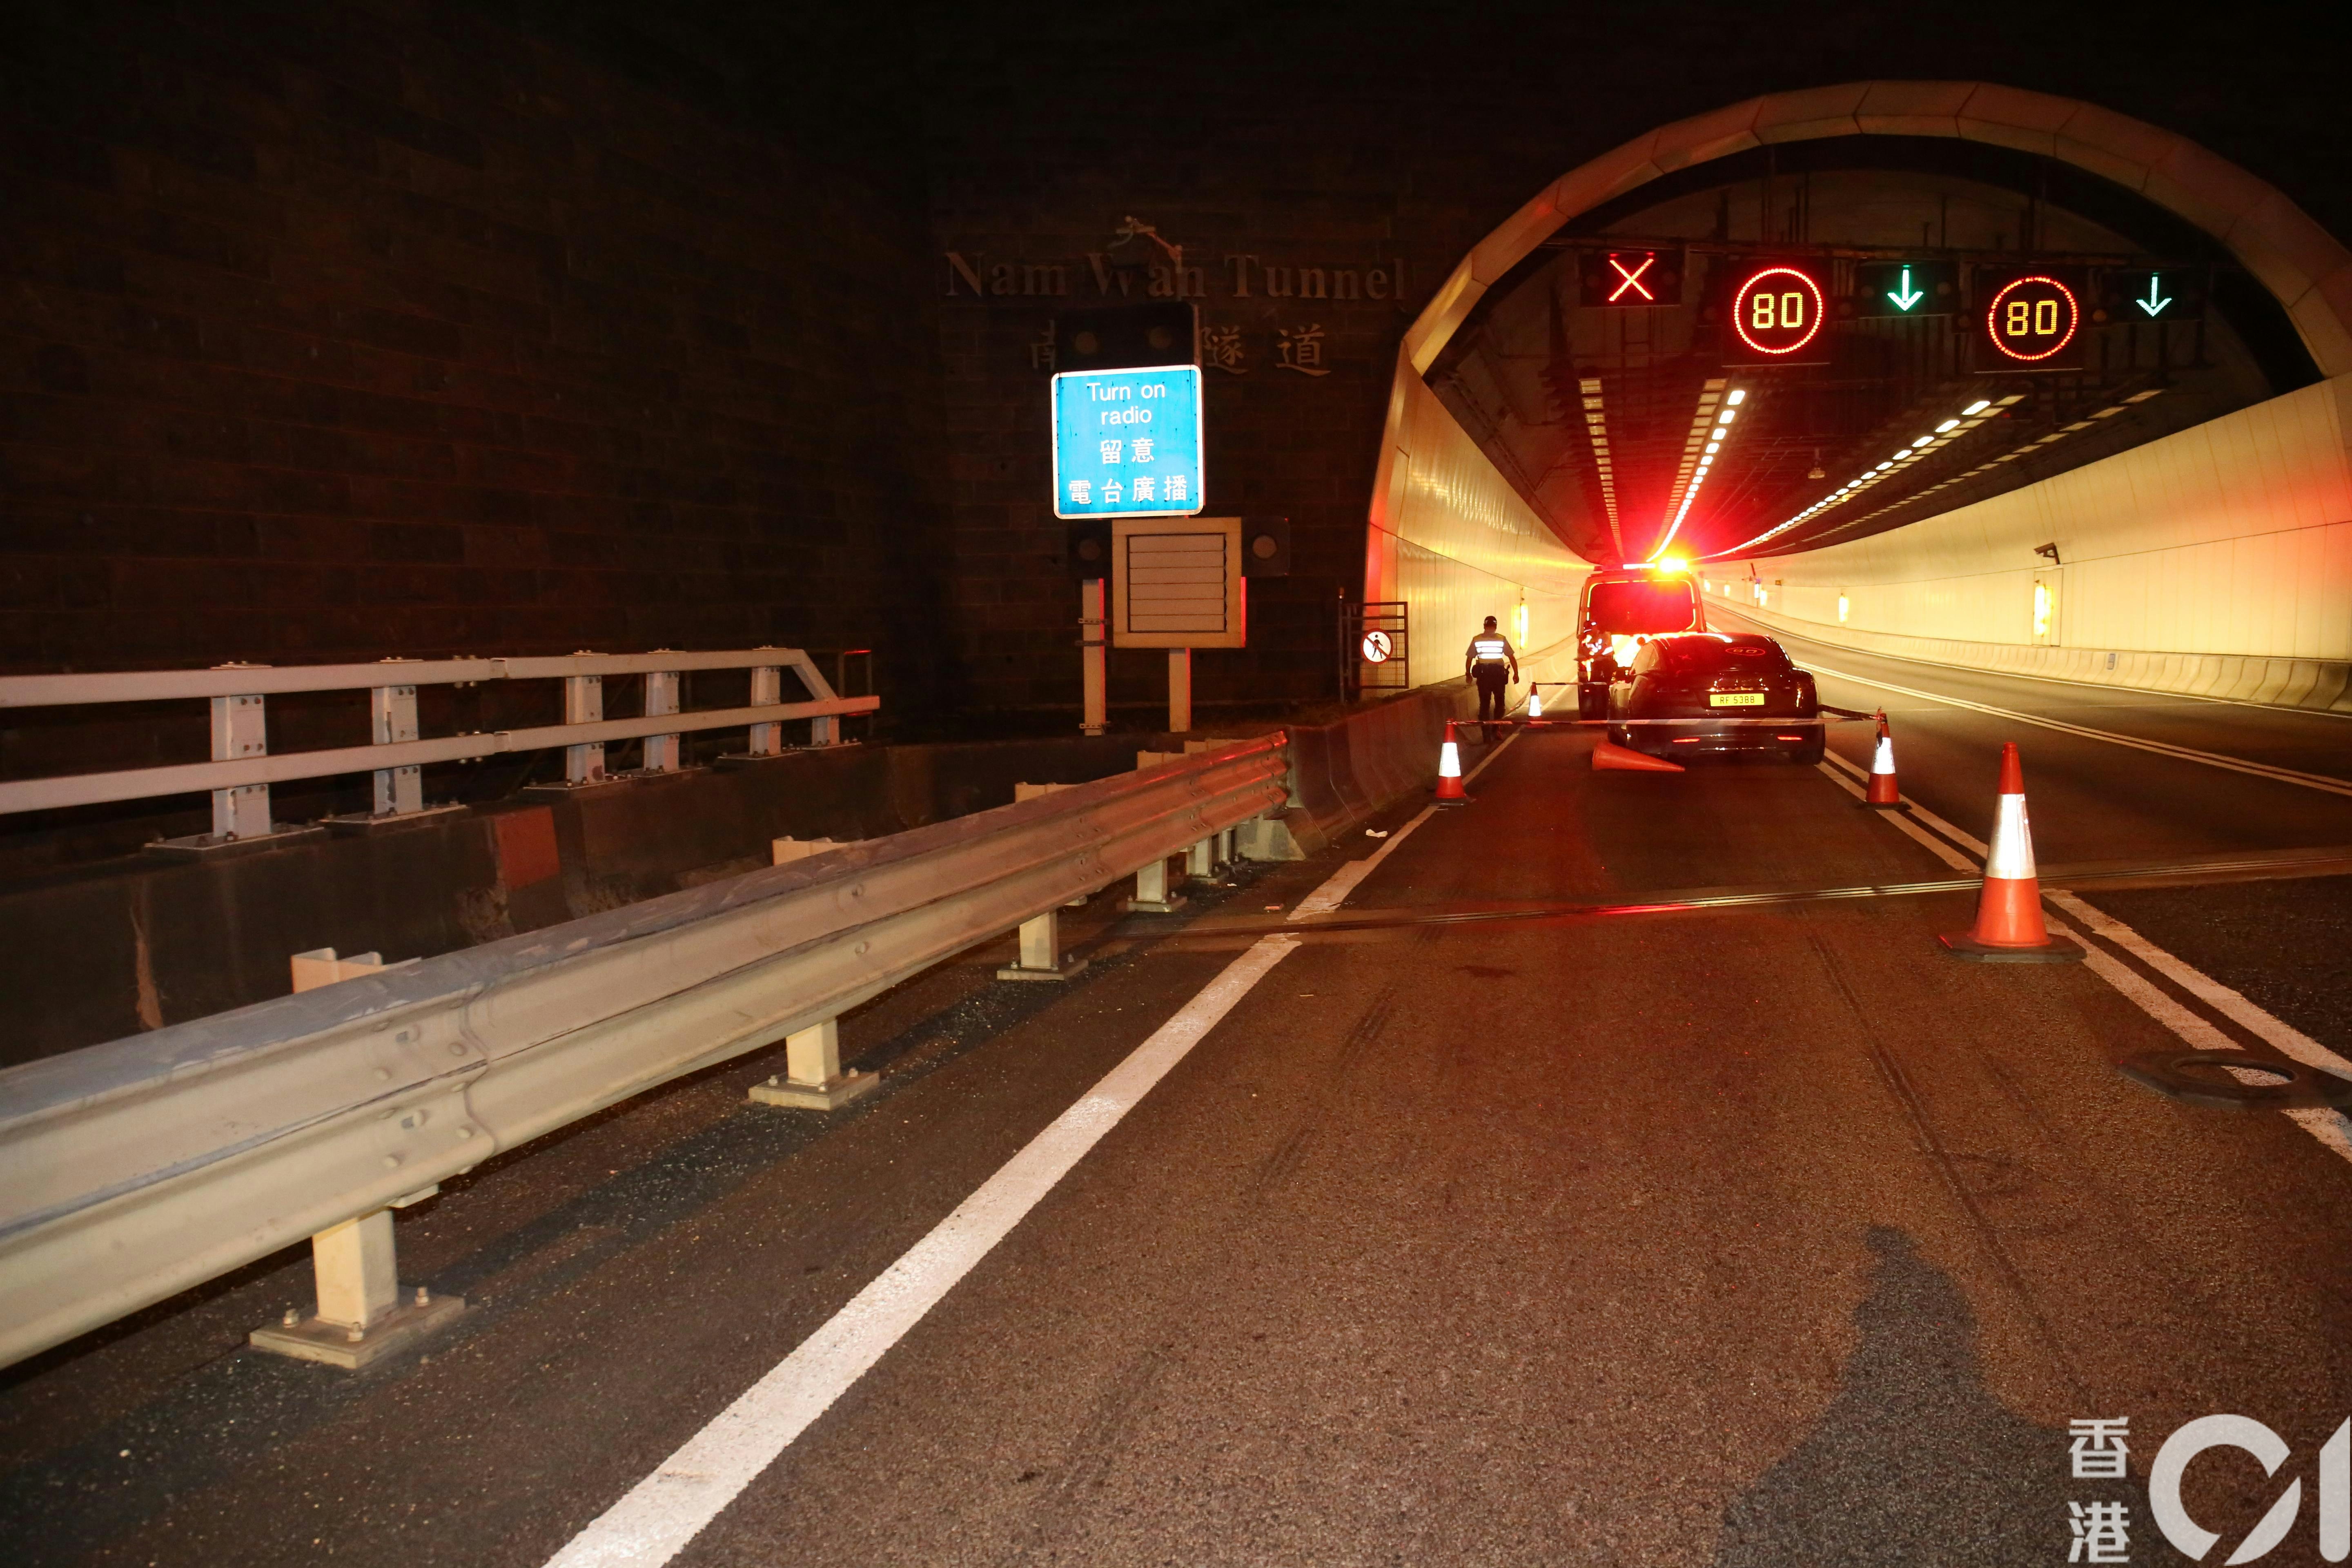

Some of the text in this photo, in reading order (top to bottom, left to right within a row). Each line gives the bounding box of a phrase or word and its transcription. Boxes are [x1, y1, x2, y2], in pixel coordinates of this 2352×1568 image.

[944, 252, 1405, 301] Nam Wan Tunnel
[1753, 292, 1803, 329] 80
[2007, 300, 2058, 336] 80
[1086, 382, 1166, 401] Turn on
[1101, 405, 1152, 425] radio
[1100, 437, 1155, 464] 留意
[1069, 474, 1188, 504] 電台廣播
